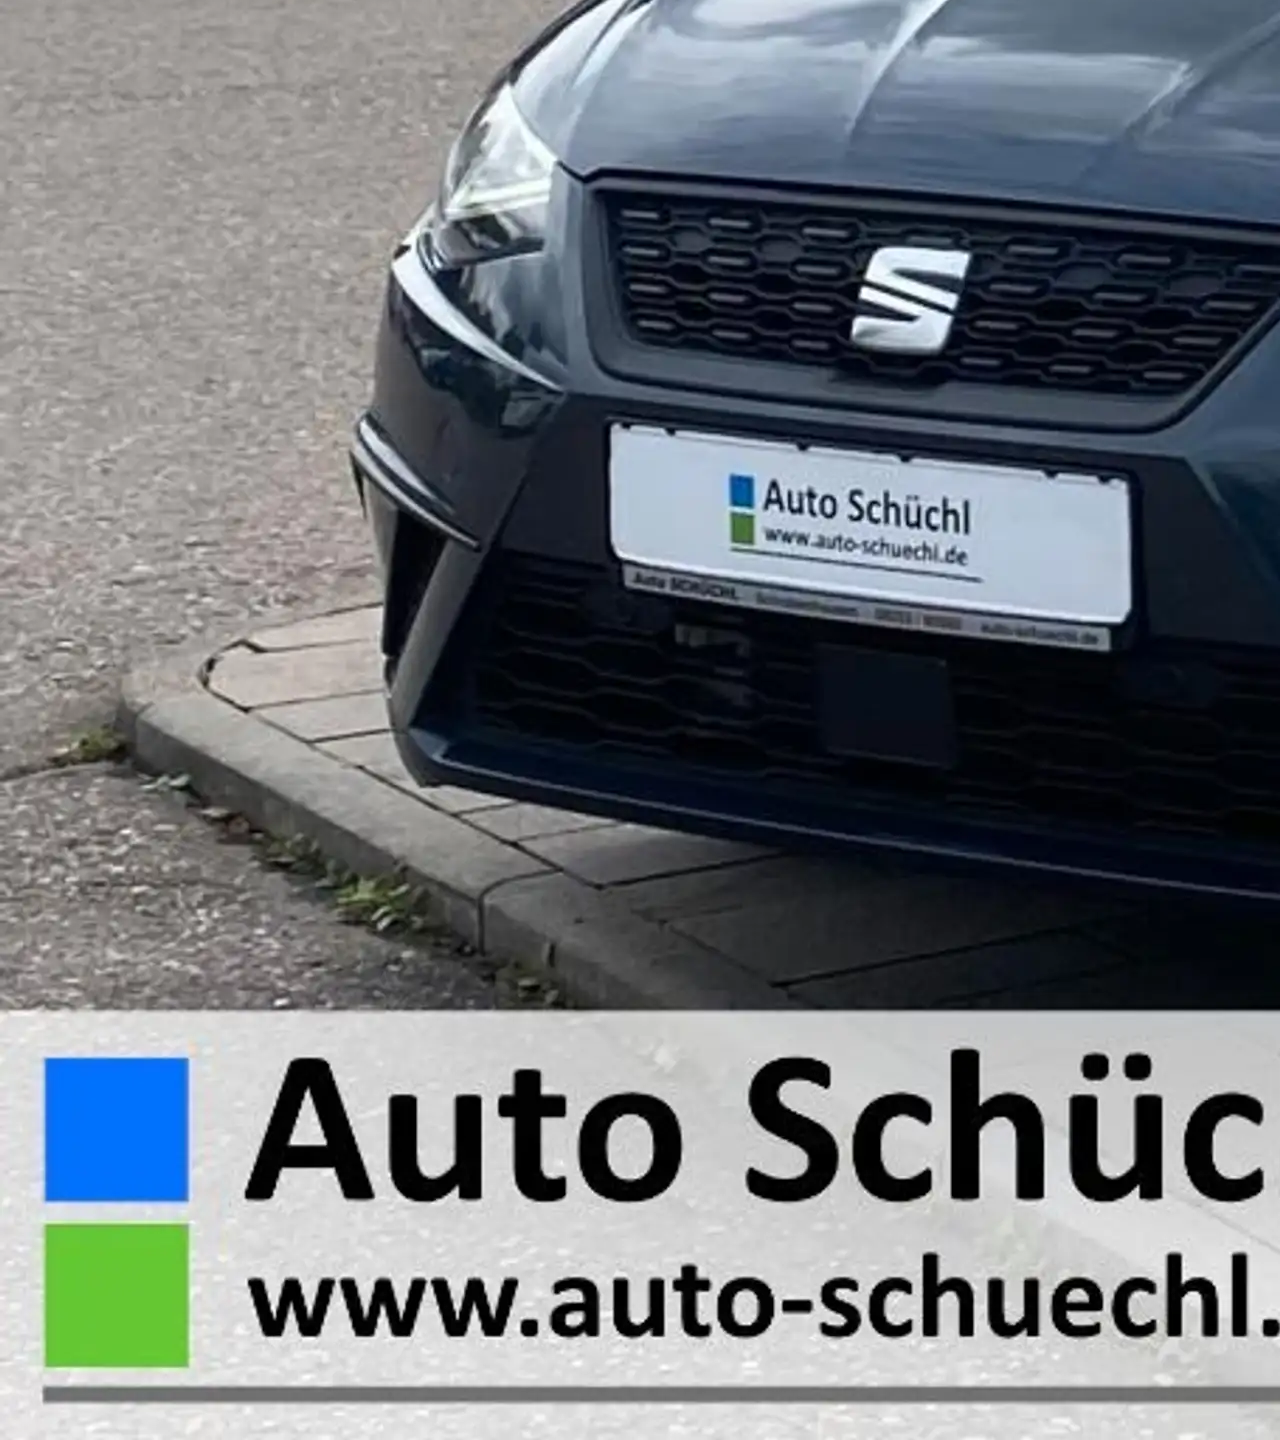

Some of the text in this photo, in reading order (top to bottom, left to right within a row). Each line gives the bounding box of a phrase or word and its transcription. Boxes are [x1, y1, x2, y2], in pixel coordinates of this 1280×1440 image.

[763, 479, 971, 536] Auto Schüchl
[763, 525, 969, 567] www.auto-schuechl.de
